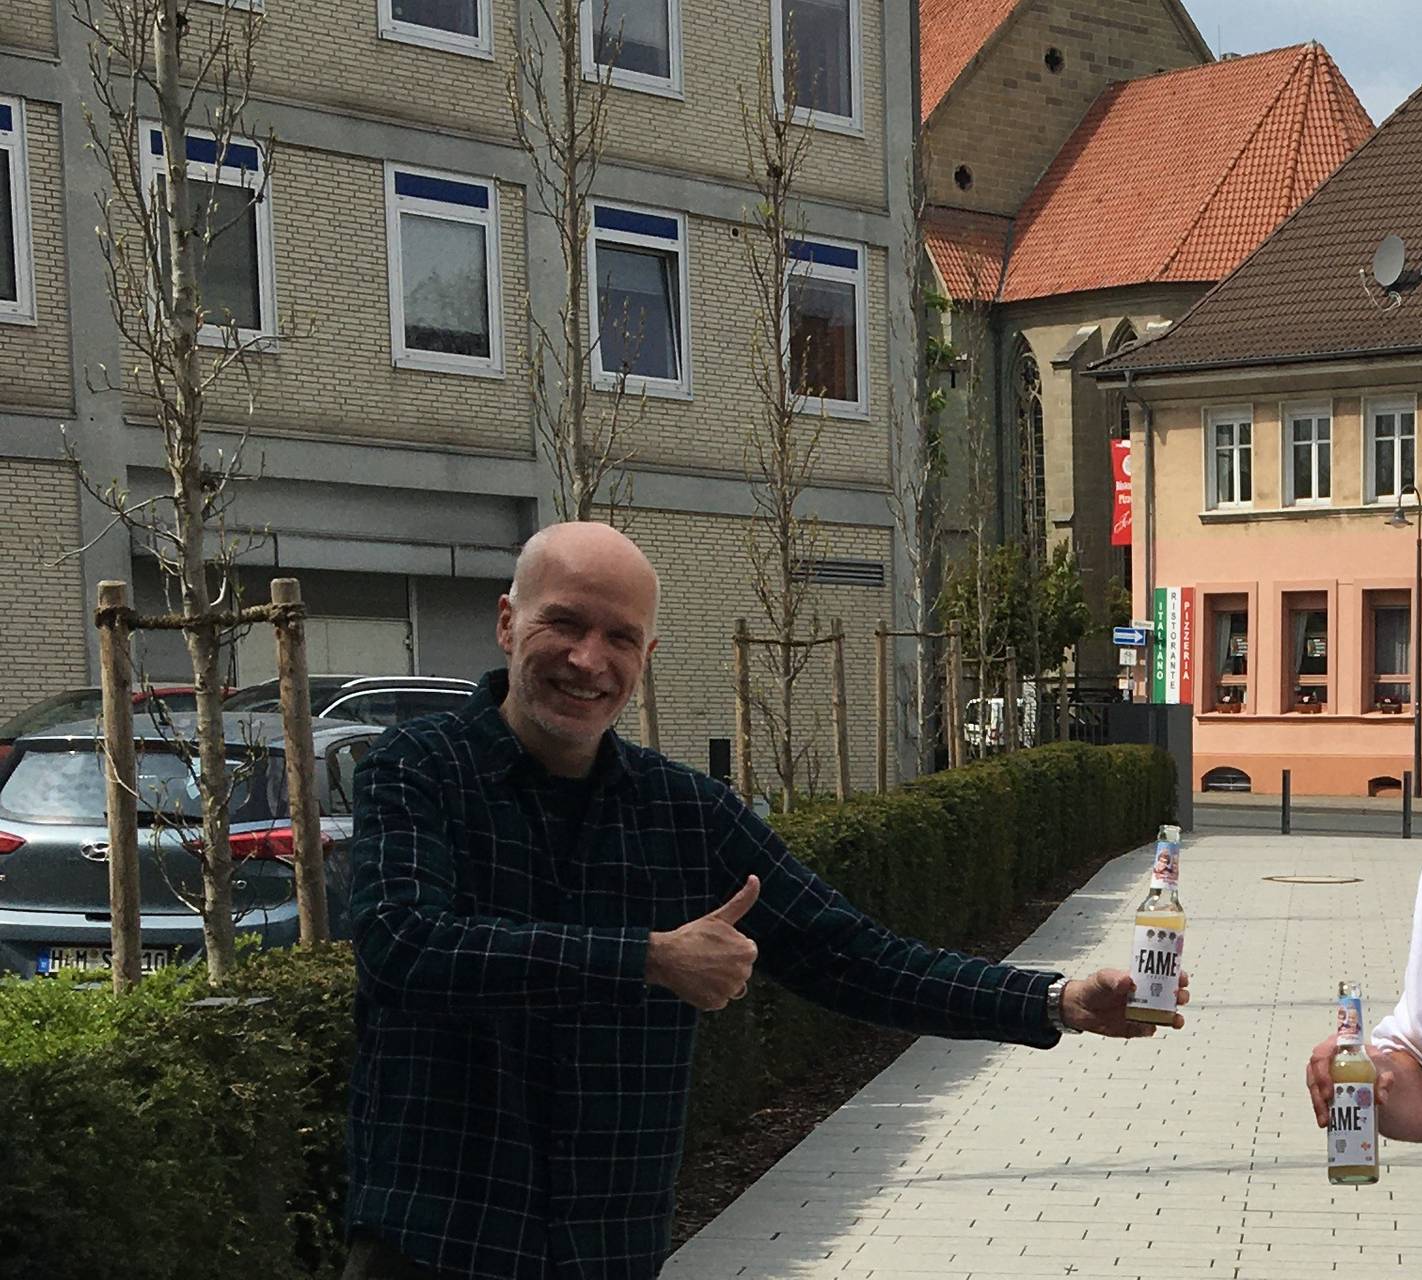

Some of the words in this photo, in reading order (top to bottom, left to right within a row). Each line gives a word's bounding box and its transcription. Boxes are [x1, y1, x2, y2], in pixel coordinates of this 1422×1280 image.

[1157, 602, 1165, 680] ITALIANO
[1137, 949, 1179, 977] FAME
[1328, 1106, 1362, 1132] AME
